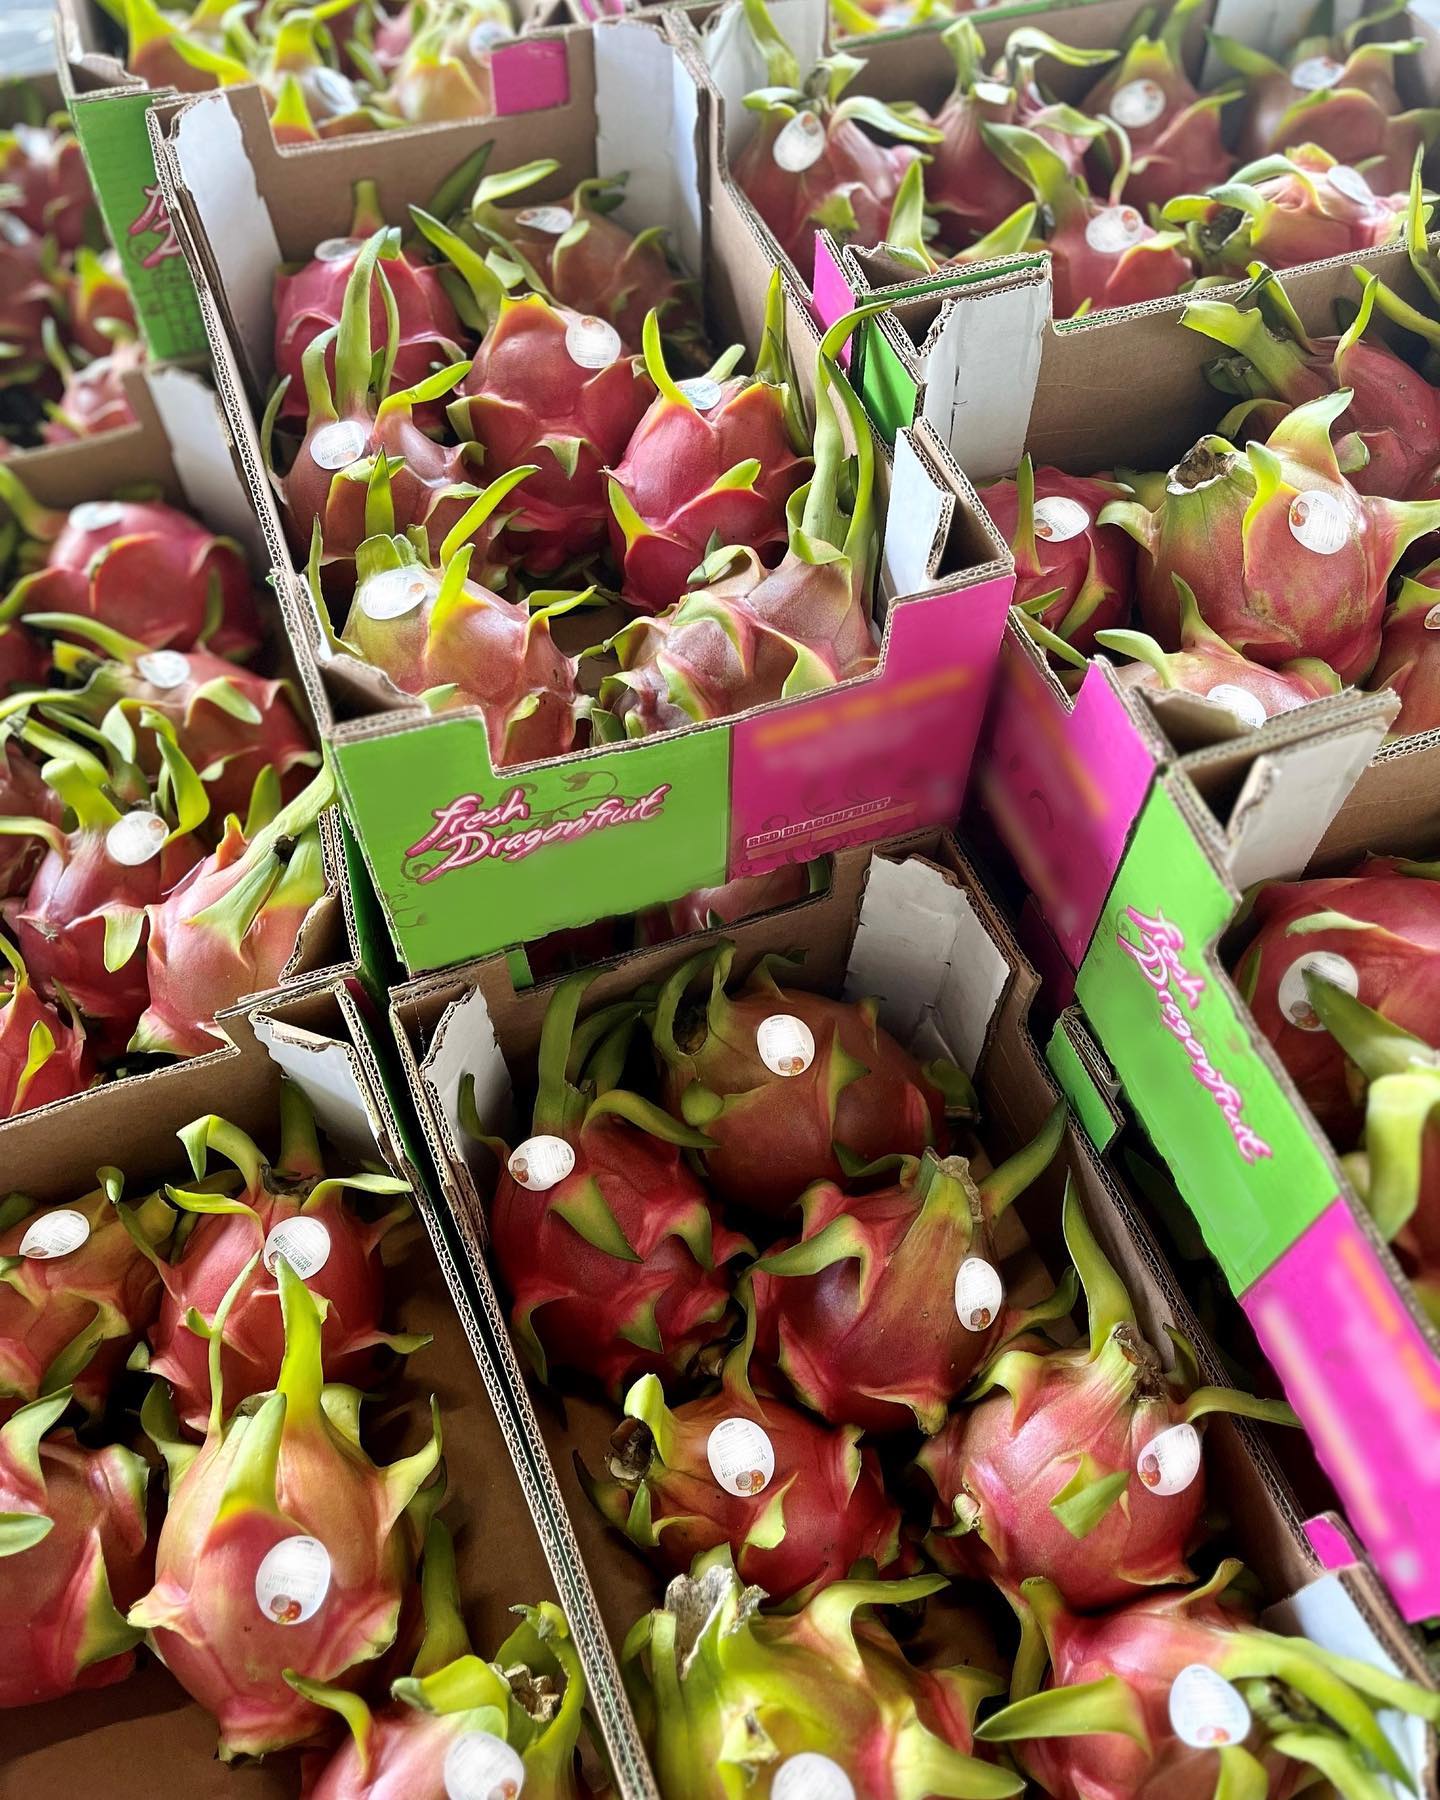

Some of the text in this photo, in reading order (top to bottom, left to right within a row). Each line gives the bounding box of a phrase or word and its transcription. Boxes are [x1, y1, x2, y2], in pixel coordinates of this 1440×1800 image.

[406, 788, 531, 857] fresh
[416, 783, 672, 885] Dragonfruit
[746, 797, 891, 848] RED DRAGONFRUIT
[1116, 931, 1273, 1166] Dragonfruit
